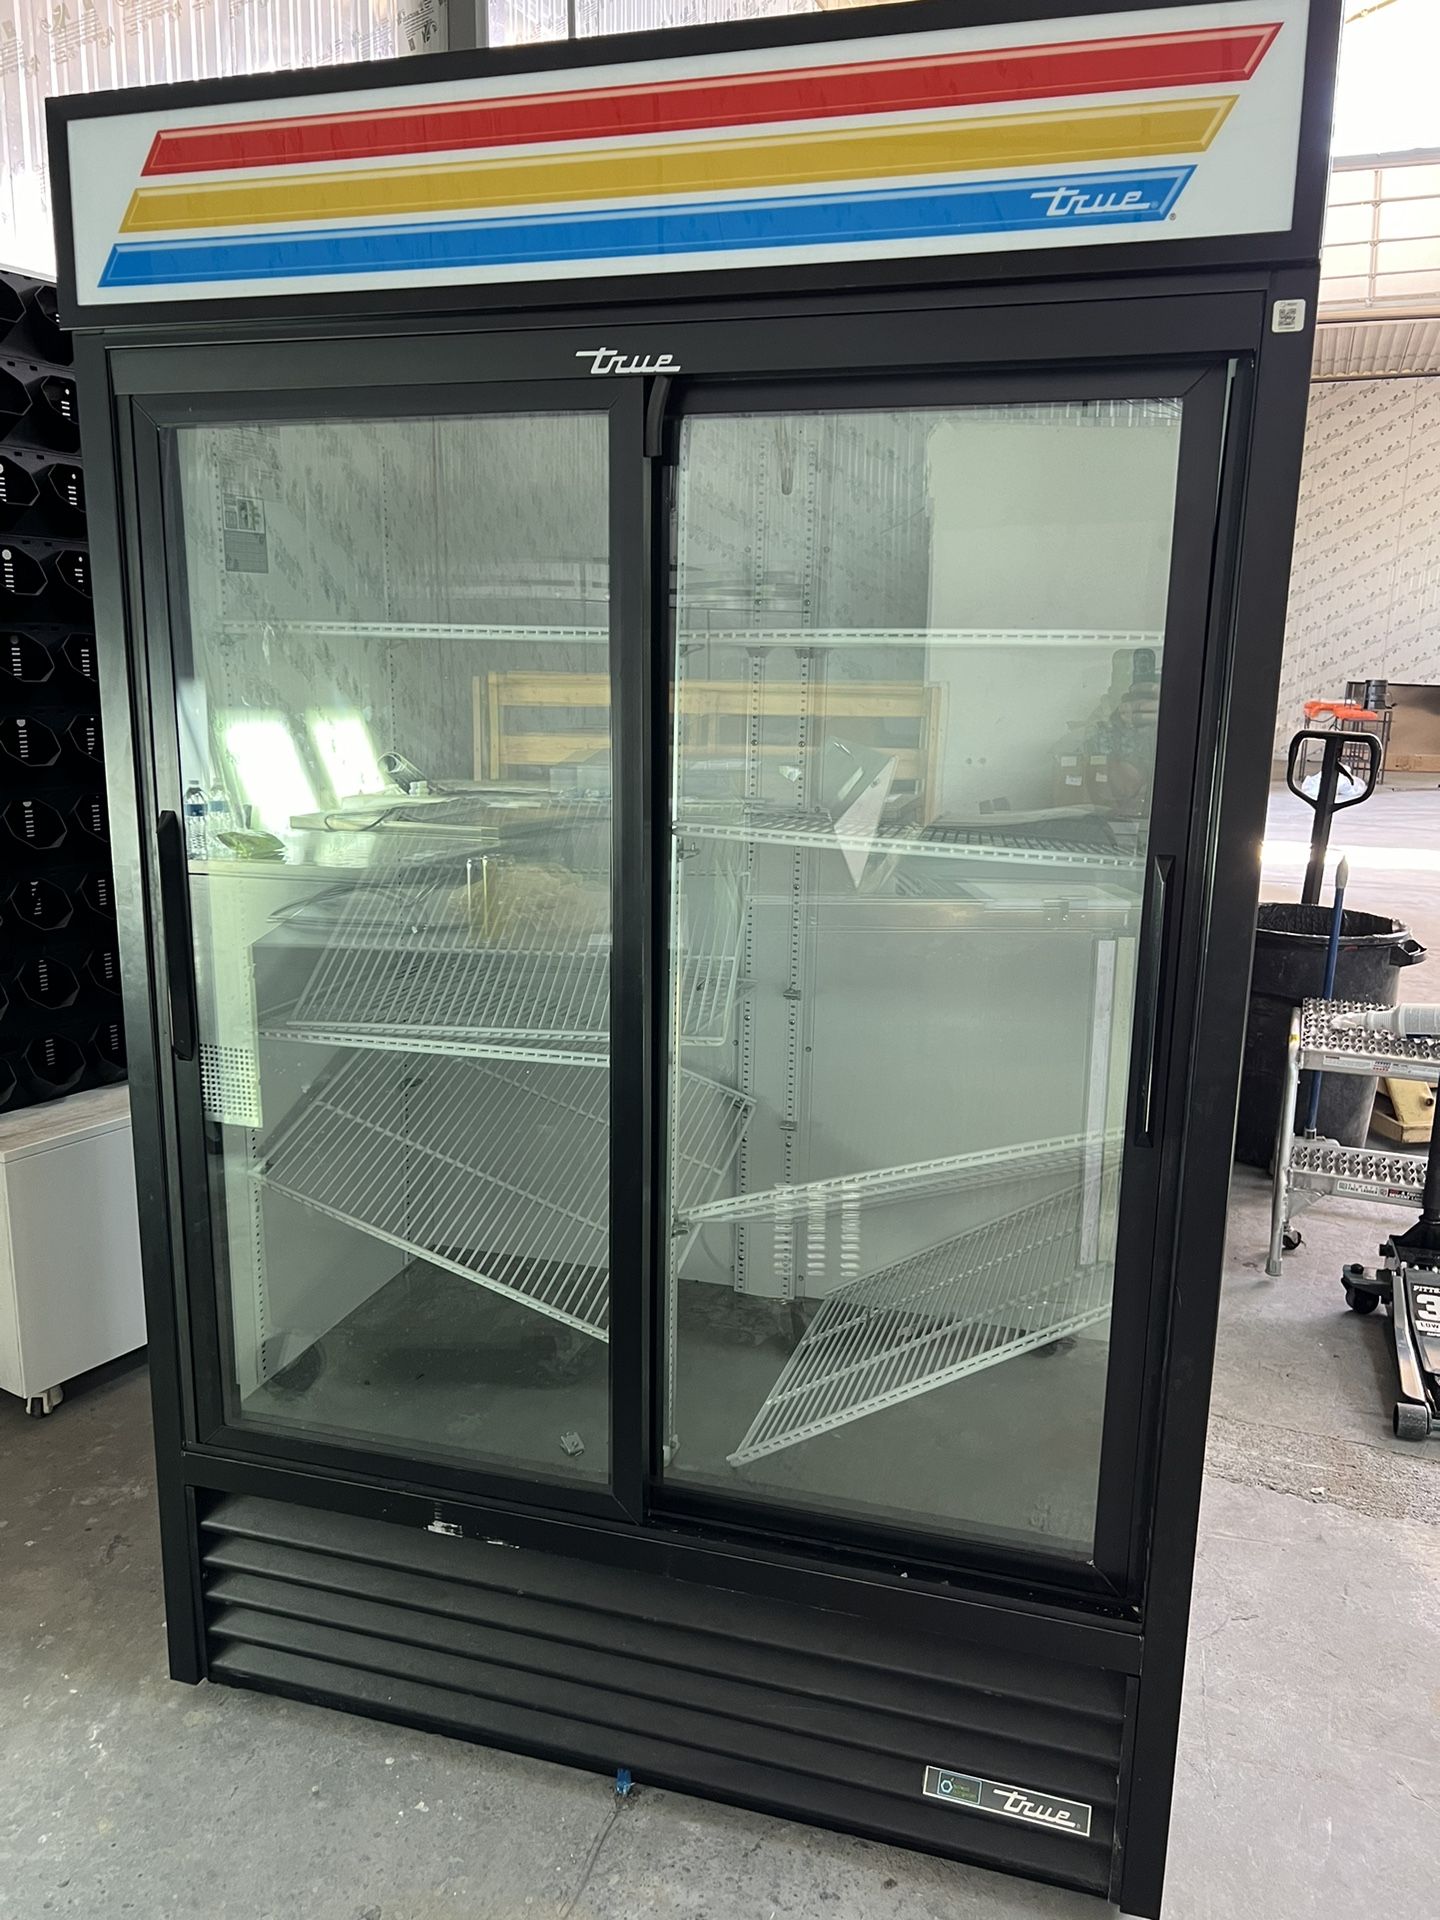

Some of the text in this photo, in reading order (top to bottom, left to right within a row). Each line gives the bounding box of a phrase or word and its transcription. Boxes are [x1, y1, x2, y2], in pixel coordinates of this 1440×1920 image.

[1030, 187, 1151, 217] true
[575, 346, 681, 374] true
[1416, 1293, 1440, 1321] 3
[993, 1789, 1076, 1828] true
